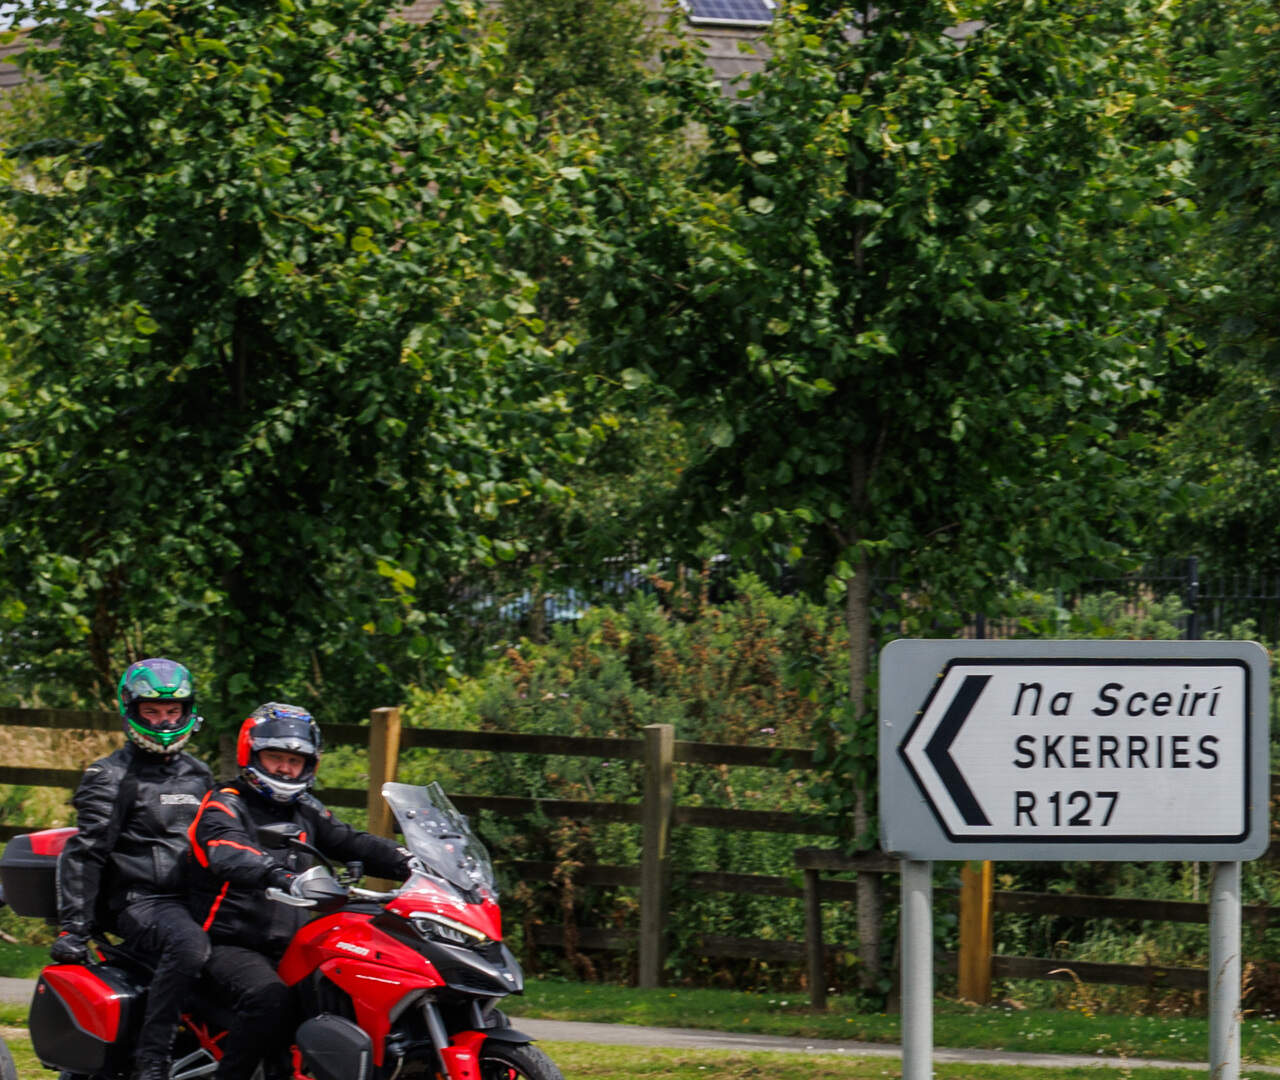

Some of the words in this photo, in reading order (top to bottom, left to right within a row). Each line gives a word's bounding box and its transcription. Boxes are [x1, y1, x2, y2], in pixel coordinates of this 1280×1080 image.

[1092, 682, 1223, 717] Sceirí
[1013, 734, 1220, 769] SKERRIES
[1014, 790, 1120, 827] R127
